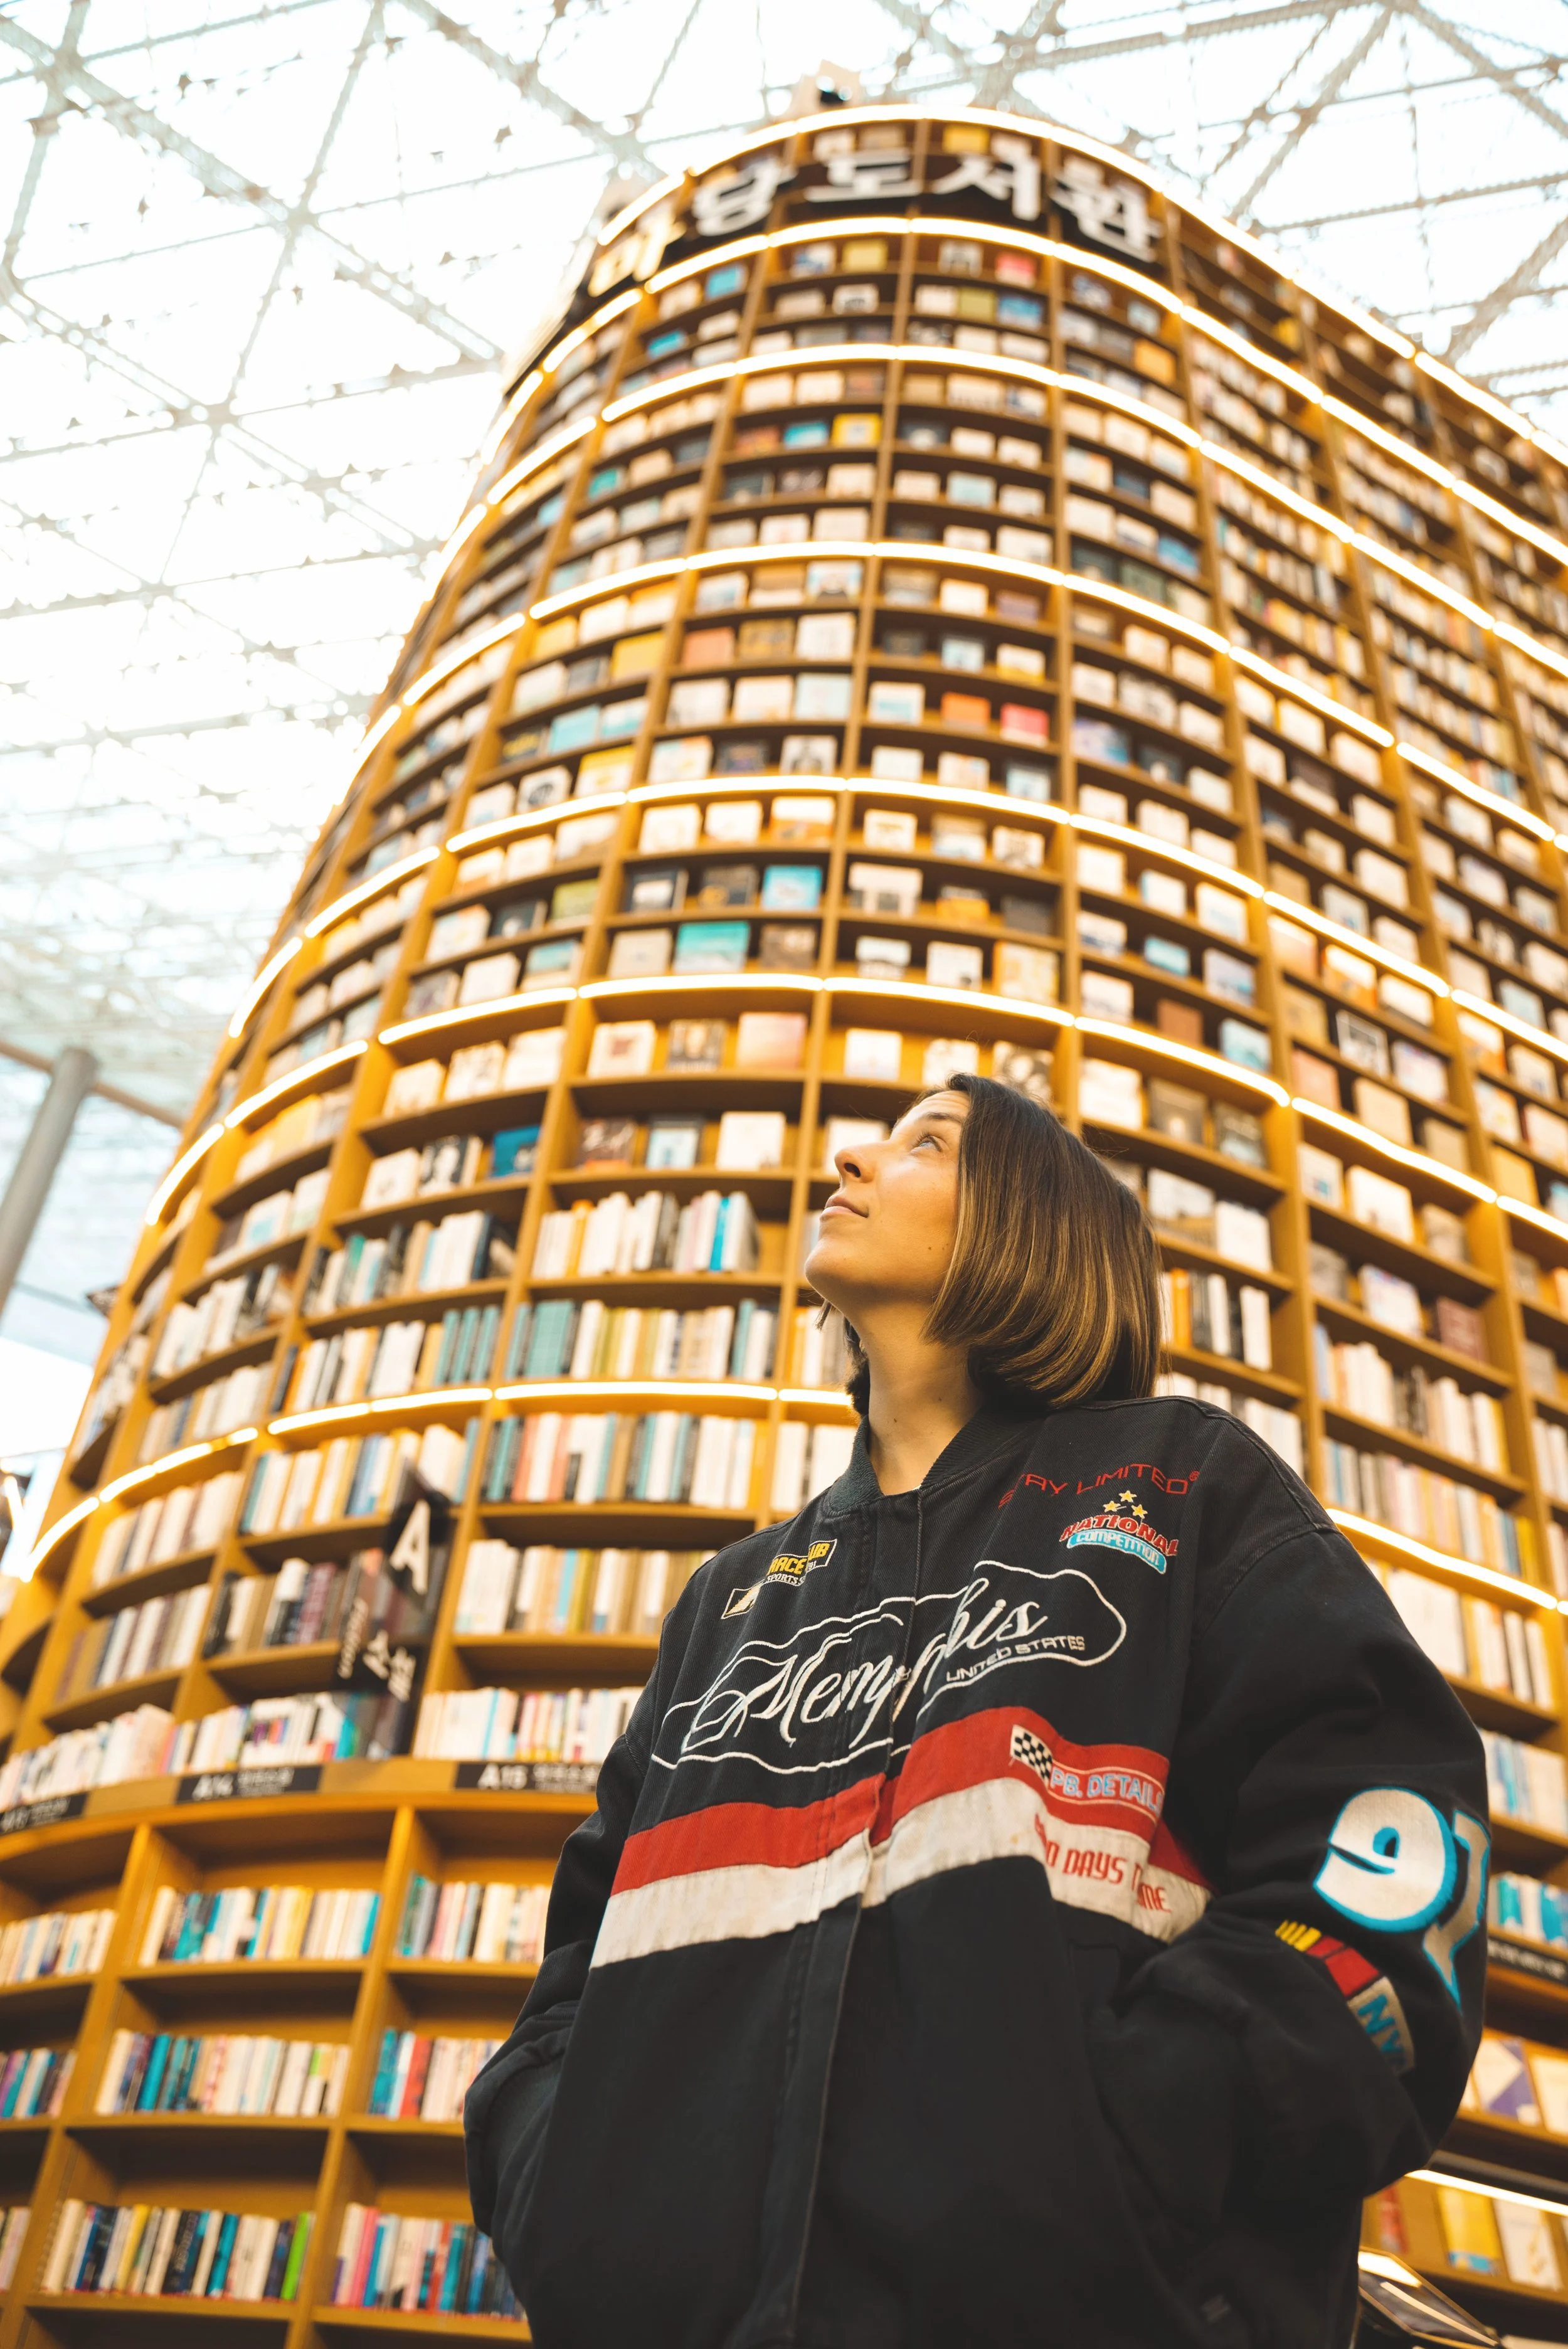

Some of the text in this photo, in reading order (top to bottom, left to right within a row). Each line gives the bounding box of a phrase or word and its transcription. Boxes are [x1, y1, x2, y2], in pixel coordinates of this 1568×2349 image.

[804, 146, 1165, 263] 도서관
[389, 1498, 431, 1596] A
[1059, 1514, 1179, 1557] NATIONAL
[683, 1577, 1048, 1751] Memphis
[946, 1635, 1086, 1682] UNITED STATES
[1062, 1848, 1128, 1885] DAYS
